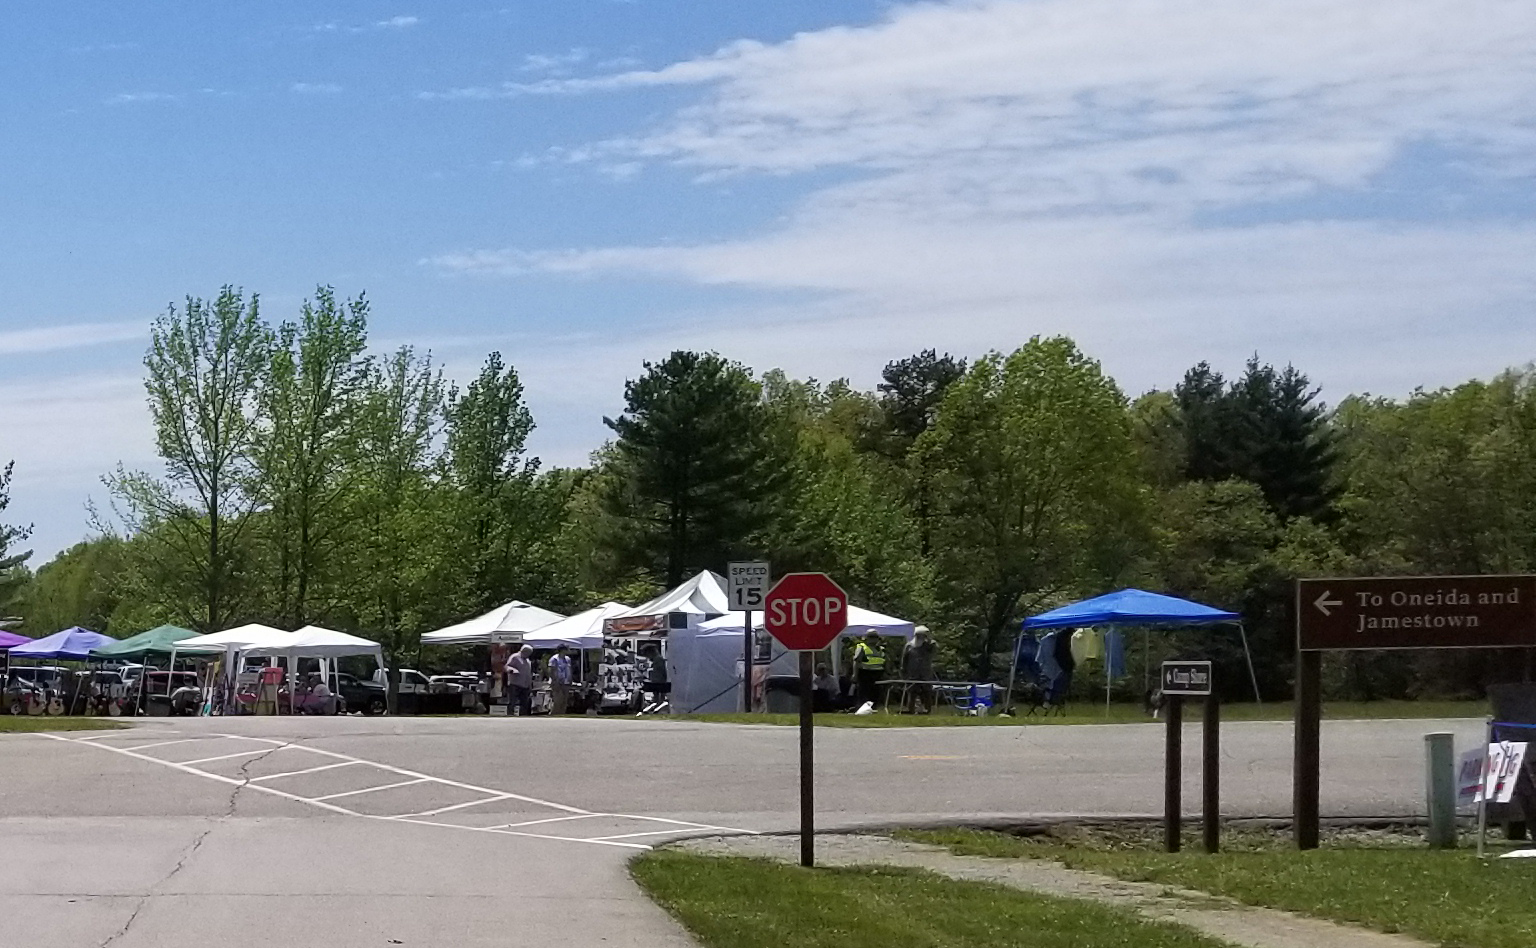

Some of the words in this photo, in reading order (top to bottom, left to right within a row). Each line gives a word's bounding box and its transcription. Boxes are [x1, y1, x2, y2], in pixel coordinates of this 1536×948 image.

[731, 567, 767, 576] SPEED
[735, 577, 762, 586] LIMIT
[735, 587, 762, 606] 15
[1355, 591, 1383, 607] To
[1390, 588, 1471, 607] Oneida
[1477, 587, 1520, 605] and
[769, 597, 842, 627] STOP
[1355, 614, 1480, 633] Jamestown
